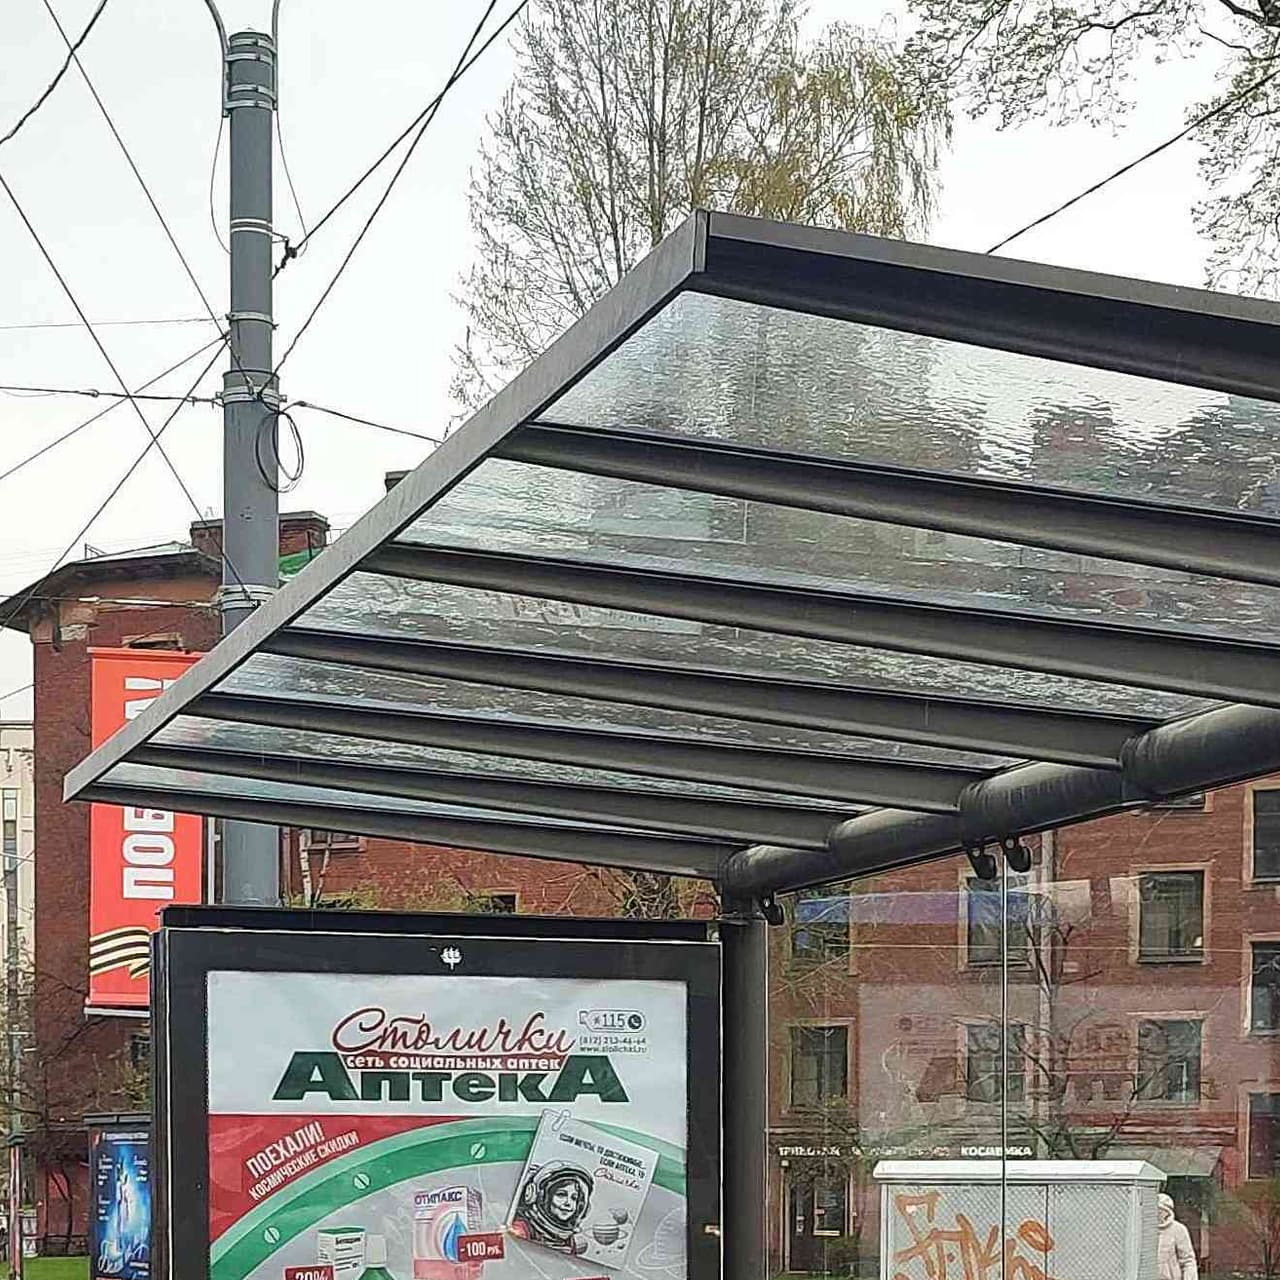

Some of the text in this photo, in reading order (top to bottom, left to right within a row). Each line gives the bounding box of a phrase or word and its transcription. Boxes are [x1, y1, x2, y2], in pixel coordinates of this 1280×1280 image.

[332, 1007, 576, 1052] Столички
[346, 1055, 561, 1071] сеть социальных аптек
[246, 1120, 326, 1179] ПОЕХАЛИ!
[248, 1130, 360, 1201] КОСМИЧЕСКИЕ СКИДКИ
[414, 1191, 463, 1206] ОТИПАКС
[460, 1241, 486, 1257] -100
